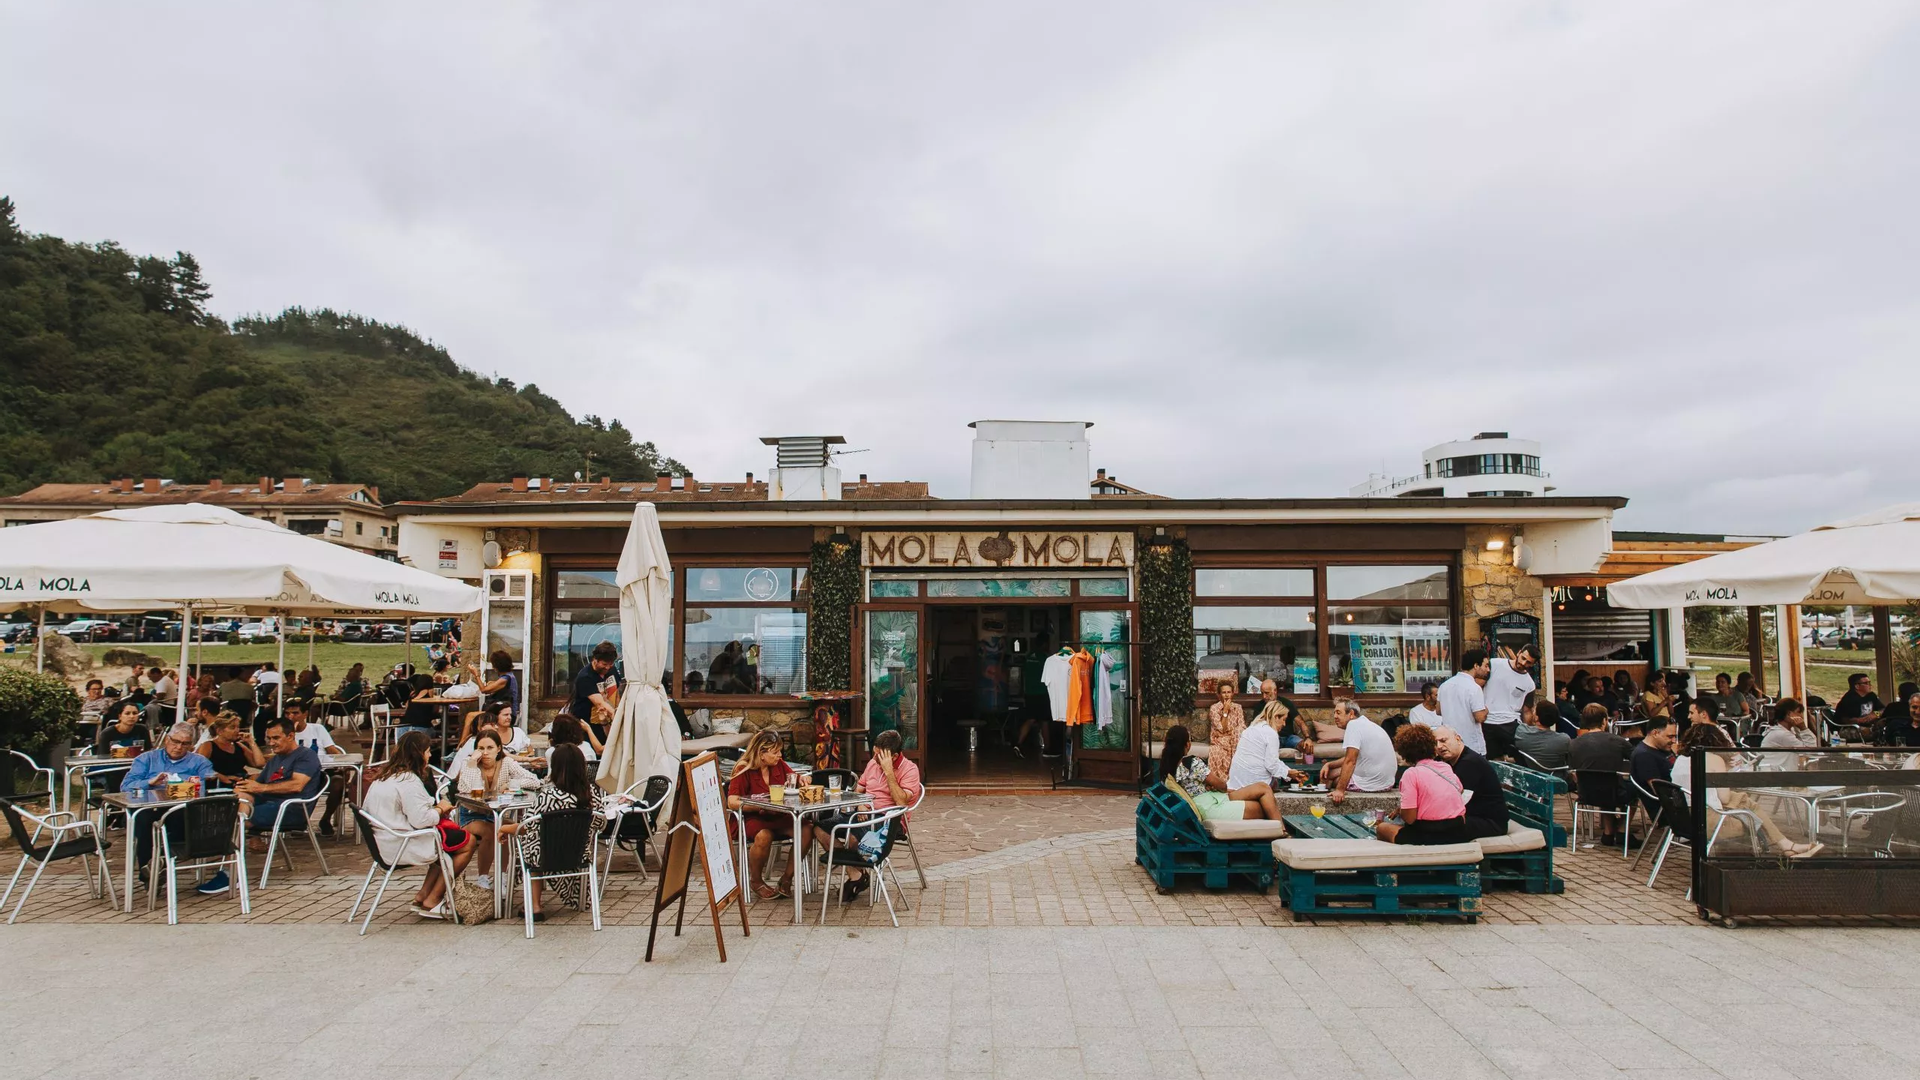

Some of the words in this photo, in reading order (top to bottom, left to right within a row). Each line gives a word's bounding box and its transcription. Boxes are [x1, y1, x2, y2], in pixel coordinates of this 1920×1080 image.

[868, 535, 972, 564] MOLA
[1022, 535, 1126, 564] MOLA
[39, 578, 91, 591] MOLA
[375, 591, 400, 604] MOLA
[1706, 587, 1738, 600] MOLA
[1360, 632, 1387, 646] SIGA
[1364, 647, 1399, 658] CORAZON
[1405, 639, 1452, 671] FELIZ
[1360, 667, 1395, 683] GPS
